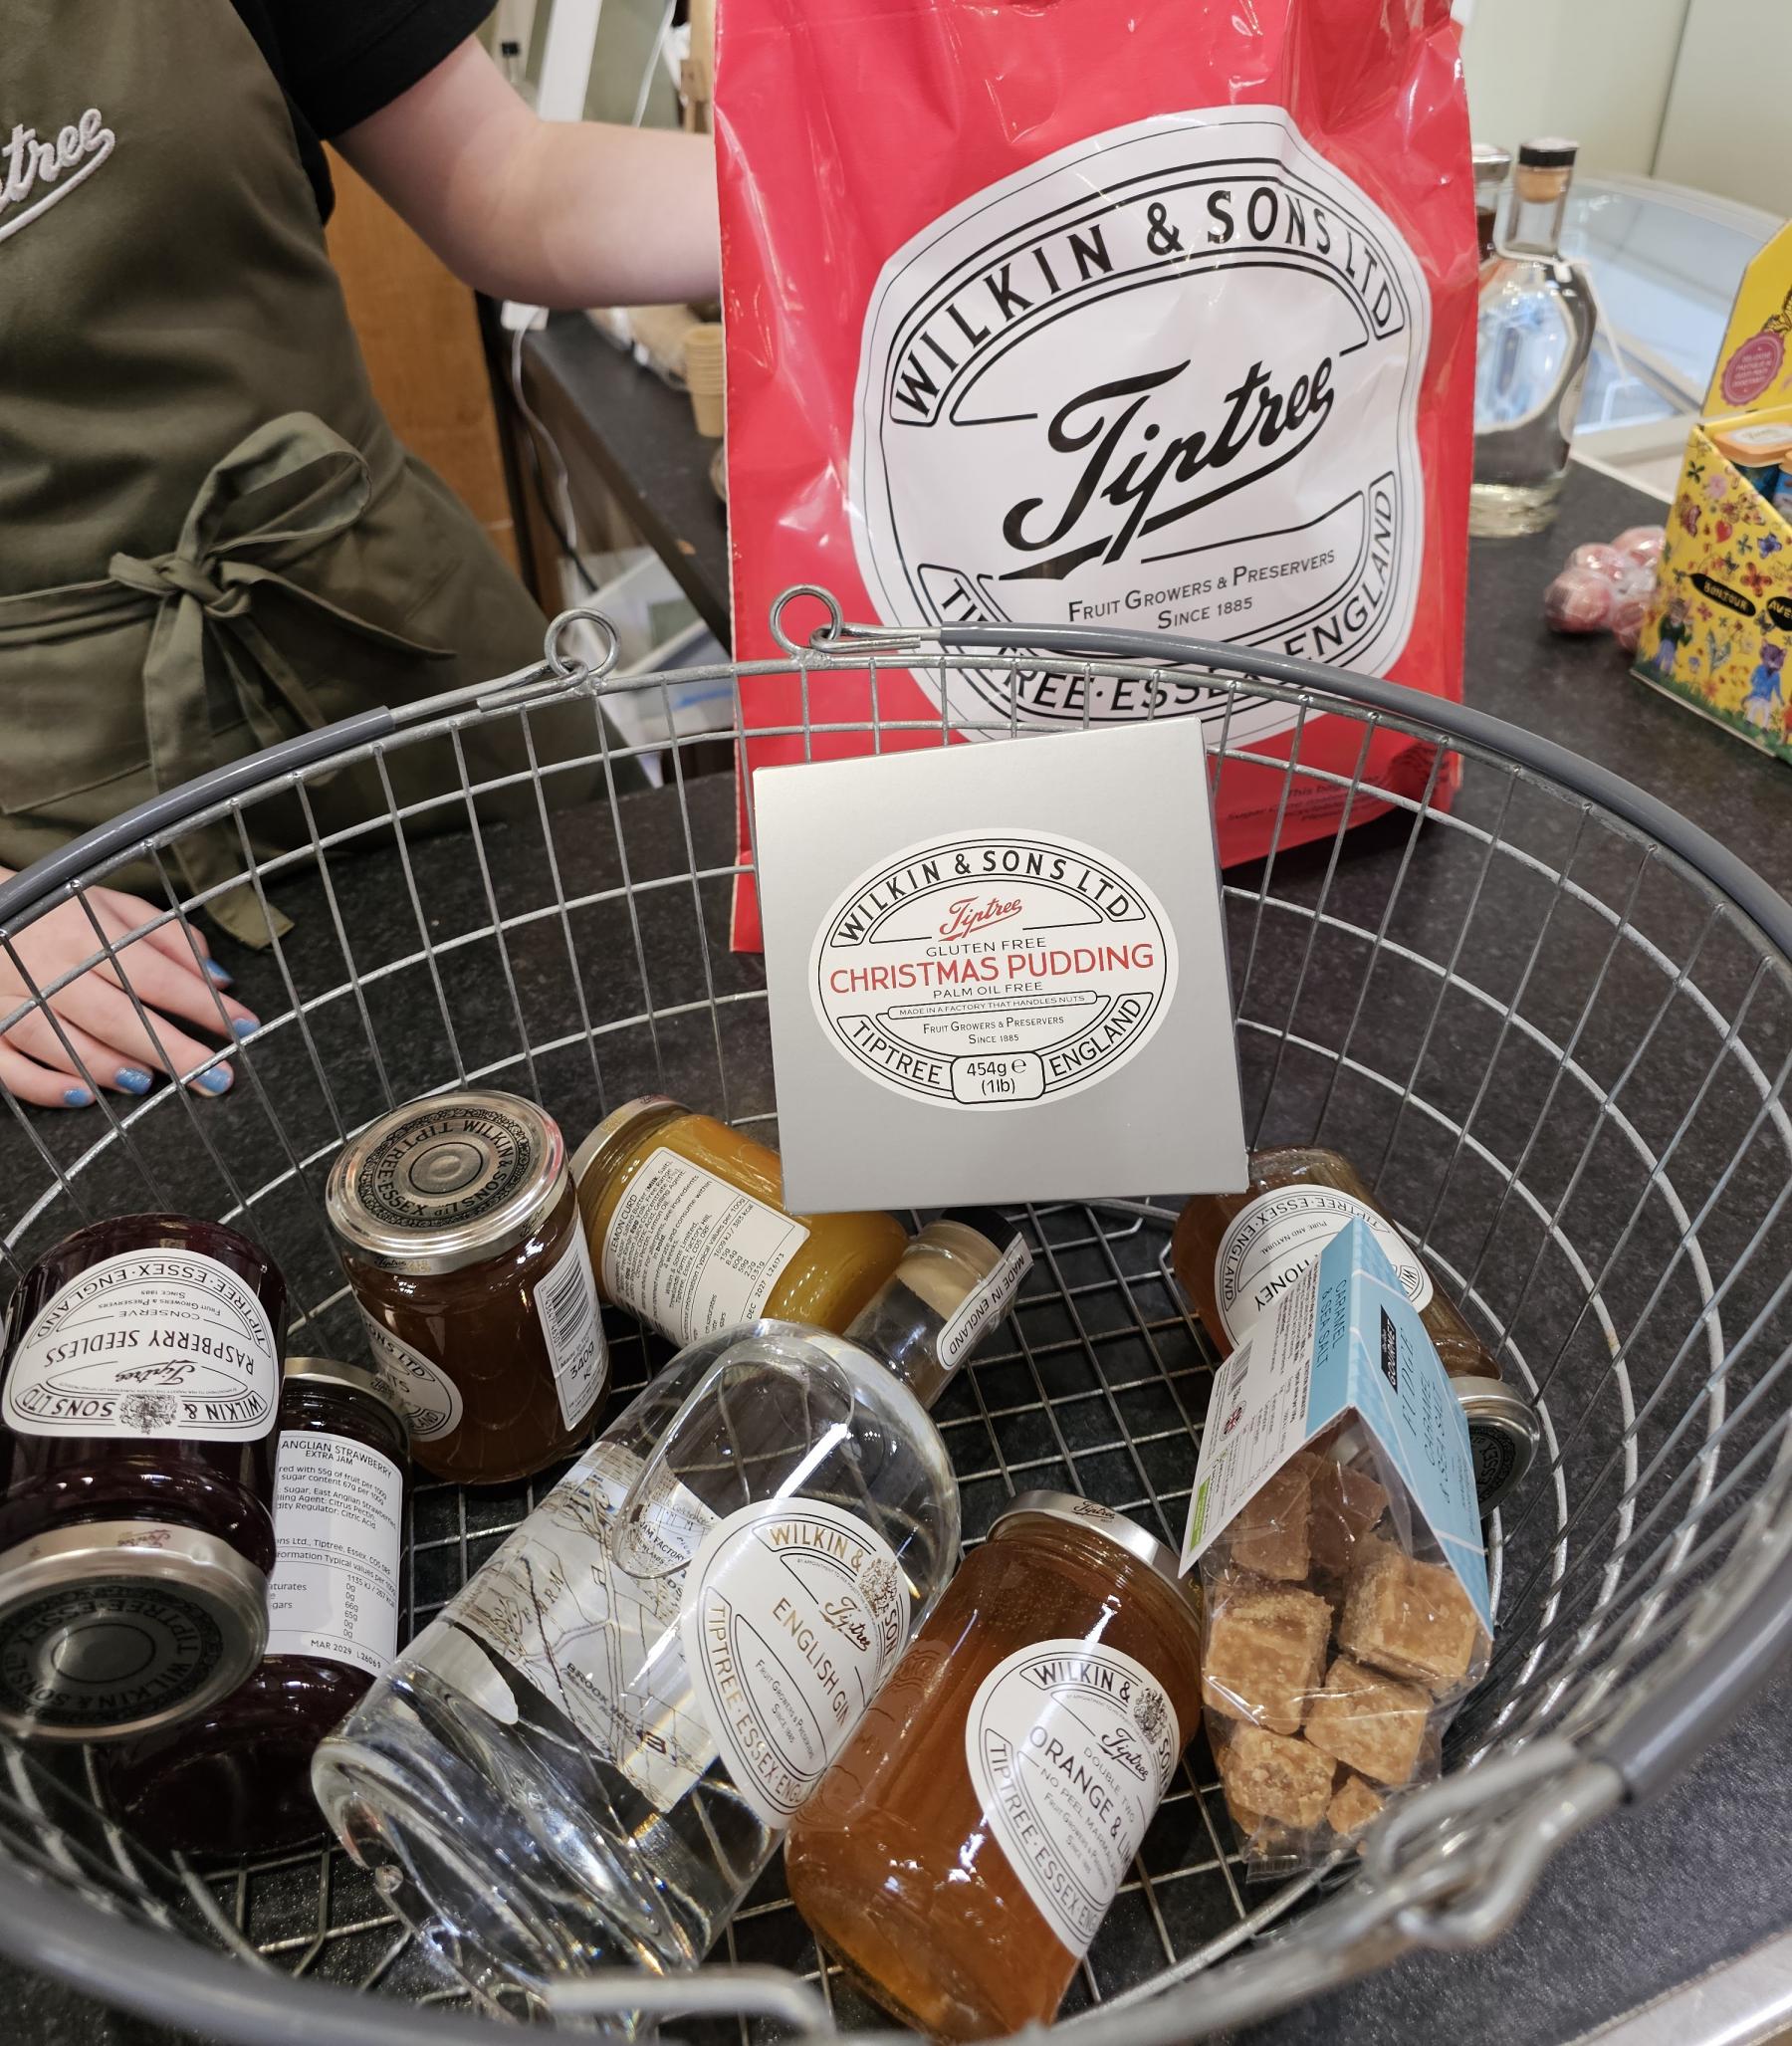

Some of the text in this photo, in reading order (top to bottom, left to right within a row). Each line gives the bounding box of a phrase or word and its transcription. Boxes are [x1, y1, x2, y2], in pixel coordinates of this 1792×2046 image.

[0, 108, 115, 242] tree
[895, 184, 1393, 416] WILKIN & SONS LTD
[1000, 355, 1335, 580] Tiptree
[1217, 576, 1228, 589] &
[1283, 490, 1392, 660] ENGLAND
[1217, 596, 1252, 616] 1885
[1703, 580, 1749, 611] BONJOUR
[838, 850, 1129, 941] WILKIN & SONS LTD
[938, 896, 1022, 942] Tiptree
[927, 938, 1046, 957] GLUTEN FREE
[830, 943, 1154, 994] CHRISTMAS PUDDING
[900, 1007, 924, 1016] MADE
[945, 1003, 986, 1012] FACTORY
[1013, 997, 1057, 1007] HANDLES
[933, 982, 1043, 999] PALM OIL FREE
[852, 1020, 943, 1085] TIPTREE
[1048, 999, 1141, 1076] ENGLAND
[967, 1061, 1007, 1076] 454g
[982, 1078, 1015, 1095] (1lb)
[377, 1122, 453, 1180] TIPTREE
[463, 1120, 514, 1207] WILKIN & SONS
[377, 1182, 428, 1217] ESSEX
[672, 1175, 699, 1210] ingredients
[676, 1180, 712, 1228] consume within
[610, 1194, 637, 1252] LEMON CURD
[1262, 1198, 1308, 1226] ESSEX
[696, 1198, 746, 1269] Typical values per 100g
[714, 1204, 754, 1257] 1609 kcal
[720, 1248, 731, 1261] 15g
[733, 1255, 744, 1269] 60g
[744, 1261, 757, 1276] 2.2g
[751, 1260, 766, 1281] 0.31g
[1225, 1225, 1255, 1300] ENGLAND
[37, 1262, 265, 1346] TIPTREE ESSEX ENGLAND
[118, 1309, 200, 1320] CONSERVE
[747, 1302, 757, 1319] DEC
[755, 1279, 767, 1297] 2027
[949, 1255, 1025, 1355] MADE IN ENGLAND
[1332, 1279, 1347, 1349] CARAMEL
[1316, 1300, 1332, 1369] SEA SALT
[1387, 1318, 1397, 1385] GOURMET
[44, 1329, 255, 1376] RASPBERRY SEEDLESS
[399, 1354, 425, 1377] LTD
[570, 1341, 594, 1379] 340g
[114, 1359, 199, 1386] Tiptree
[22, 1387, 51, 1411] LTD
[51, 1398, 116, 1418] SONS
[184, 1404, 198, 1418] &
[206, 1394, 264, 1421] WILKIN
[281, 1440, 392, 1478] ANGLIAN STRAWBERRY
[306, 1450, 353, 1466] EXTRA JAM
[309, 1474, 340, 1486] content
[343, 1480, 356, 1491] 67g
[319, 1467, 333, 1477] 55g
[344, 1473, 360, 1484] fruit
[362, 1479, 373, 1489] per
[314, 1487, 331, 1496] East
[333, 1490, 360, 1505] Anglian
[330, 1498, 352, 1510] Citrus
[1072, 1500, 1115, 1519] Tiptree
[341, 1509, 360, 1521] Citric
[770, 1523, 864, 1572] WILKIN &
[326, 1555, 351, 1567] Typical
[352, 1563, 373, 1578] values
[347, 1574, 362, 1586] 1135
[345, 1583, 355, 1592] 0g
[345, 1592, 355, 1601] 0g
[343, 1619, 353, 1629] 0g
[344, 1601, 358, 1612] 66g
[344, 1611, 358, 1622] 65g
[343, 1628, 353, 1639] 0g
[818, 1597, 871, 1652] Tiptree
[311, 1639, 332, 1649] MAR
[773, 1597, 840, 1696] ENGLISH
[707, 1604, 780, 1784] TIPTREE ESSEX
[1033, 1662, 1130, 1703] WILKIN &
[1084, 1746, 1122, 1796] DOUBLE
[1097, 1727, 1149, 1781] Tiptree
[1029, 1726, 1114, 1823] ORANGE
[1110, 1816, 1121, 1839] &
[1041, 1767, 1083, 1818] NO PEEL
[989, 1742, 1079, 1914] TIPTREE ESSEX
